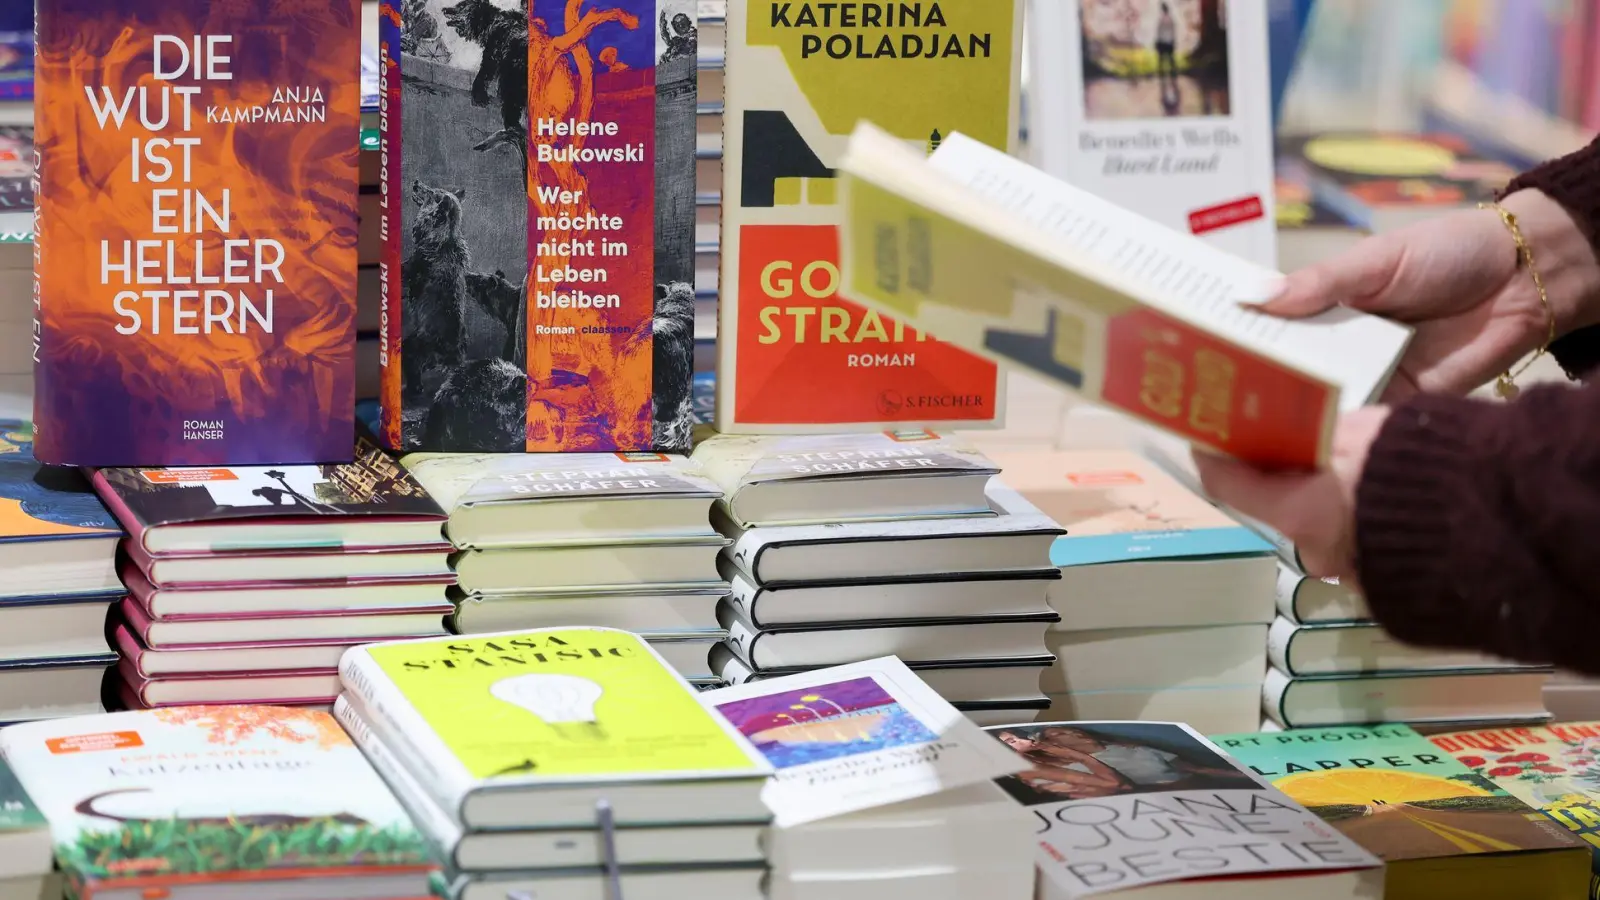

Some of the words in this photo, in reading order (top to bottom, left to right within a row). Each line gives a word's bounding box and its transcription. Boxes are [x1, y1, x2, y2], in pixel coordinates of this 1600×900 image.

[771, 2, 947, 28] KATERINA
[801, 33, 991, 59] POLADJAN
[153, 34, 233, 80] DIE
[272, 87, 324, 103] ANJA
[380, 48, 389, 132] bleiben
[85, 86, 201, 131] WUT
[206, 105, 325, 123] KAMPMANN
[537, 118, 618, 136] Helene
[132, 137, 201, 183] IST
[537, 144, 644, 163] Bukowski
[380, 139, 388, 209] Leben
[537, 186, 582, 205] Wer
[152, 188, 230, 234] EIN
[537, 212, 623, 231] möchte
[537, 238, 594, 256] nicht
[601, 238, 628, 256] im
[101, 239, 286, 284] HELLER
[537, 265, 607, 283] Leben
[537, 290, 620, 309] bleiben
[113, 289, 273, 335] STERN
[380, 262, 388, 368] Bukowski
[536, 325, 575, 335] Roman
[581, 325, 631, 335] claassen
[847, 353, 915, 368] ROMAN
[183, 420, 224, 430] ROMAN
[183, 430, 224, 440] HANSER
[777, 448, 925, 463] STEPHAN
[500, 467, 649, 482] STEPHAN
[793, 458, 938, 473] SCHÄFER
[510, 479, 661, 493] SCHÄFER
[1275, 728, 1411, 745] PRÖDEL
[1248, 754, 1448, 776] LAPPER
[1033, 793, 1303, 835] JOANA
[1072, 811, 1290, 851] JUNE
[1067, 840, 1364, 888] BESTIE
